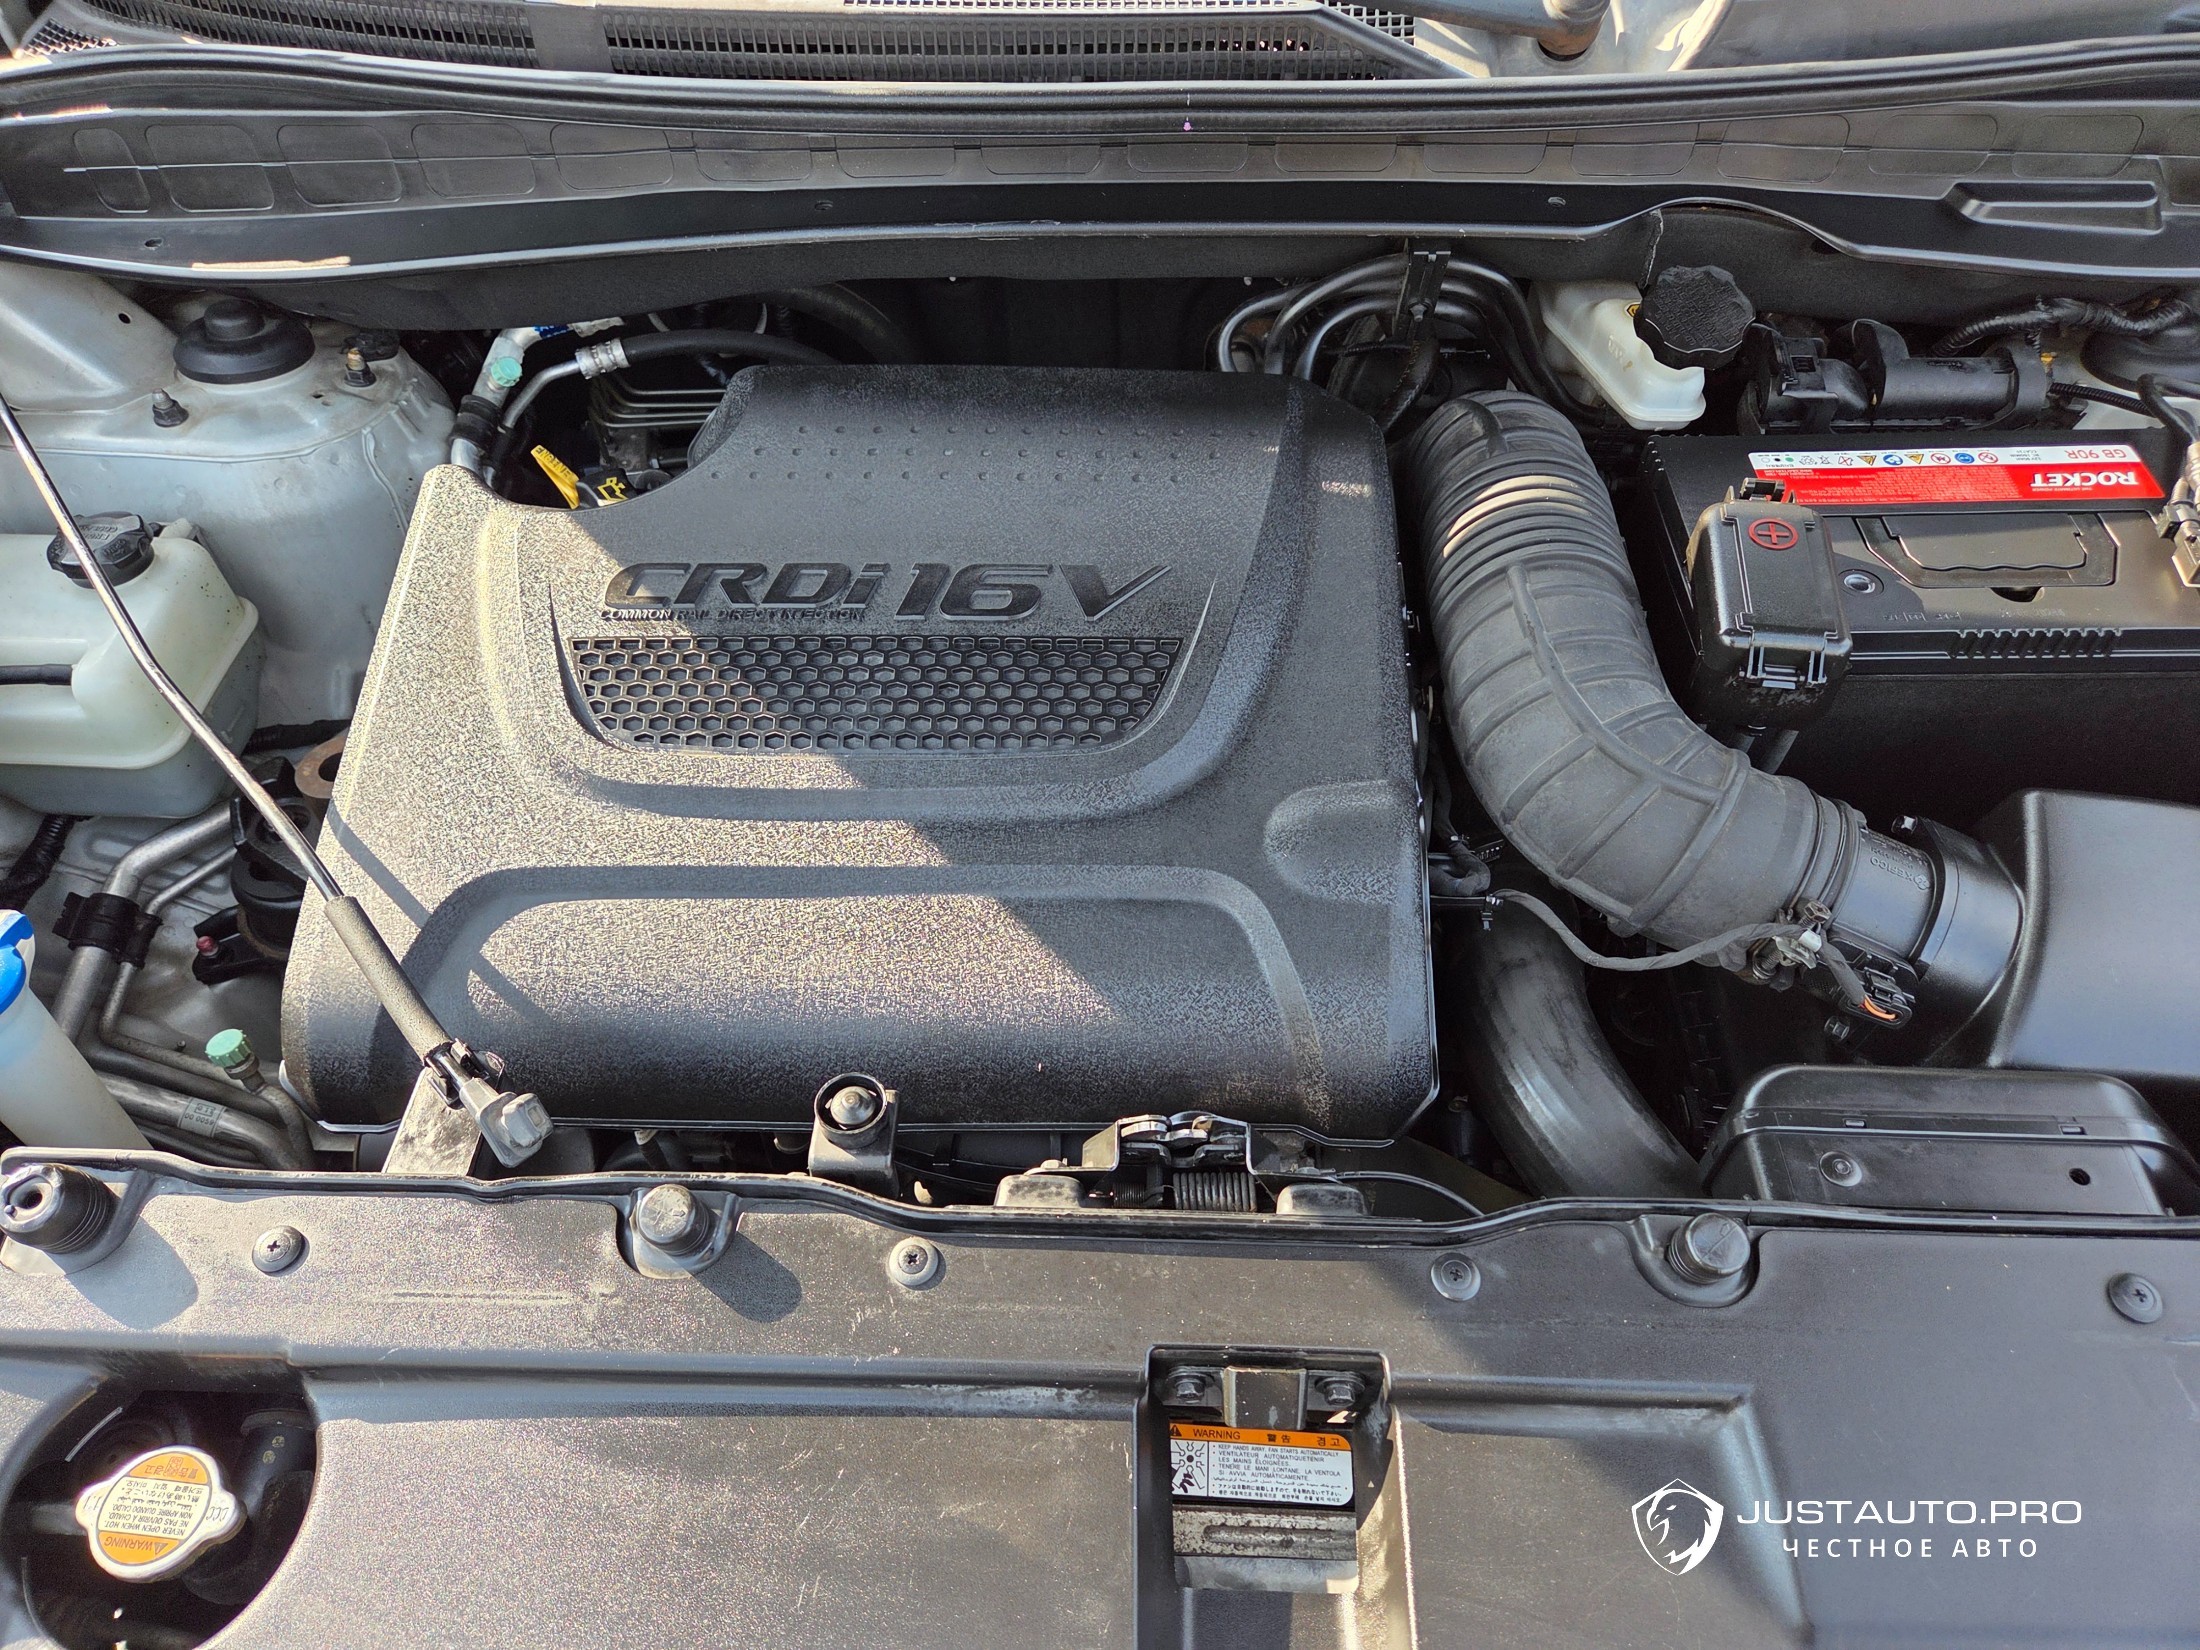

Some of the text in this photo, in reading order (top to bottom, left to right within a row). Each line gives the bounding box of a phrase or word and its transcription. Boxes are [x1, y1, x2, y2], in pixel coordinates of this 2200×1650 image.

[2064, 448, 2127, 459] GB 90R
[2030, 471, 2139, 487] ROCKET
[603, 561, 891, 609] CRDi
[598, 609, 675, 621] COMMON
[677, 609, 711, 621] RAIL
[1193, 1428, 1241, 1440] WARNING
[1317, 1436, 1341, 1447] 경고
[1218, 1450, 1259, 1459] VENTILATEUR
[1314, 1469, 1341, 1477] VENTOLA
[132, 1505, 156, 1514] QUANDO
[157, 1508, 179, 1517] APRIRE
[179, 1511, 193, 1519] NON
[138, 1515, 163, 1525] OUVRIR
[164, 1518, 178, 1526] PAS
[122, 1522, 141, 1530] WHEN
[142, 1524, 161, 1533] OPEN
[162, 1528, 185, 1536] NEVER
[104, 1536, 153, 1551] WARNING
